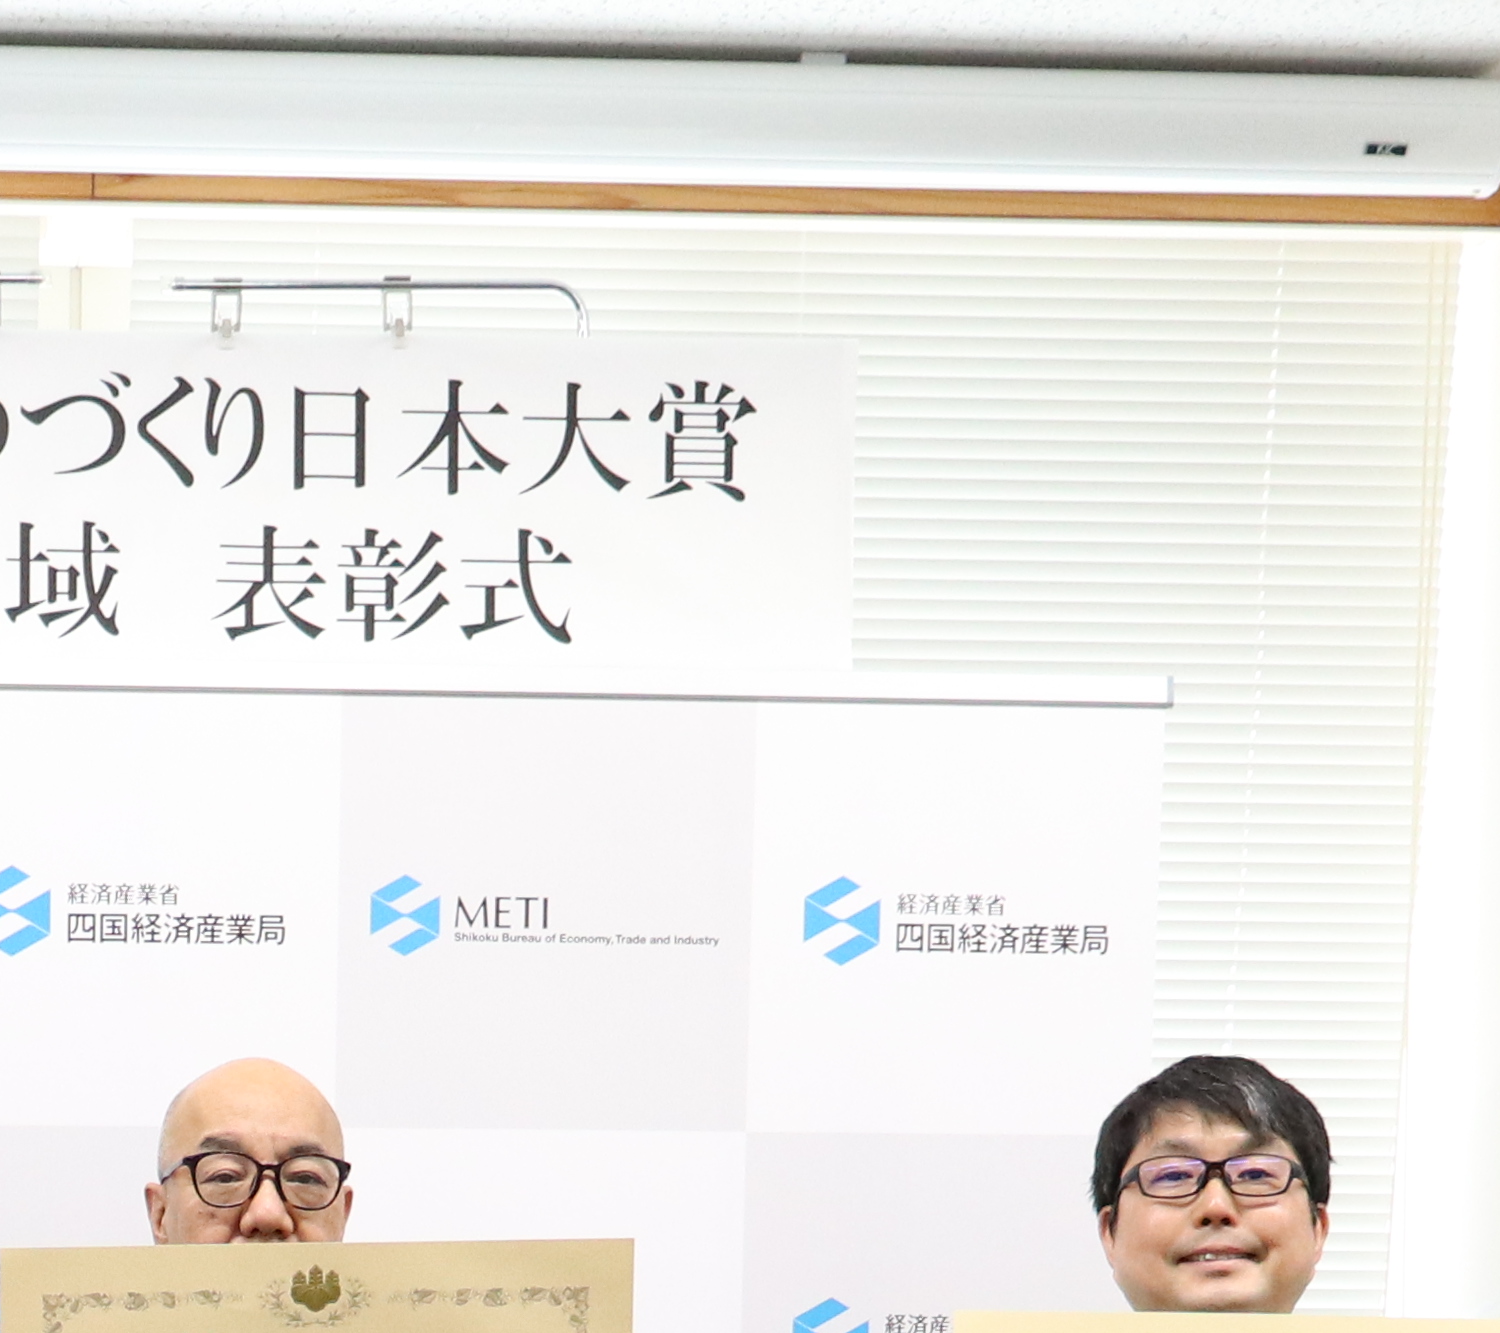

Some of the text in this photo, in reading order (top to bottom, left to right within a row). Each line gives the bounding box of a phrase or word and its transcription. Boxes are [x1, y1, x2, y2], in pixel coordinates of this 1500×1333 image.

[214, 524, 573, 645] 表彰式
[68, 883, 178, 905] 経済産業省
[898, 894, 1004, 916] 経済産業省
[454, 896, 549, 930] METI
[67, 913, 286, 946] 四国経済産業局
[454, 932, 719, 947] Shikoku Bureau of Economy, Trade and Industry
[896, 923, 1109, 955] 四国経済産業局
